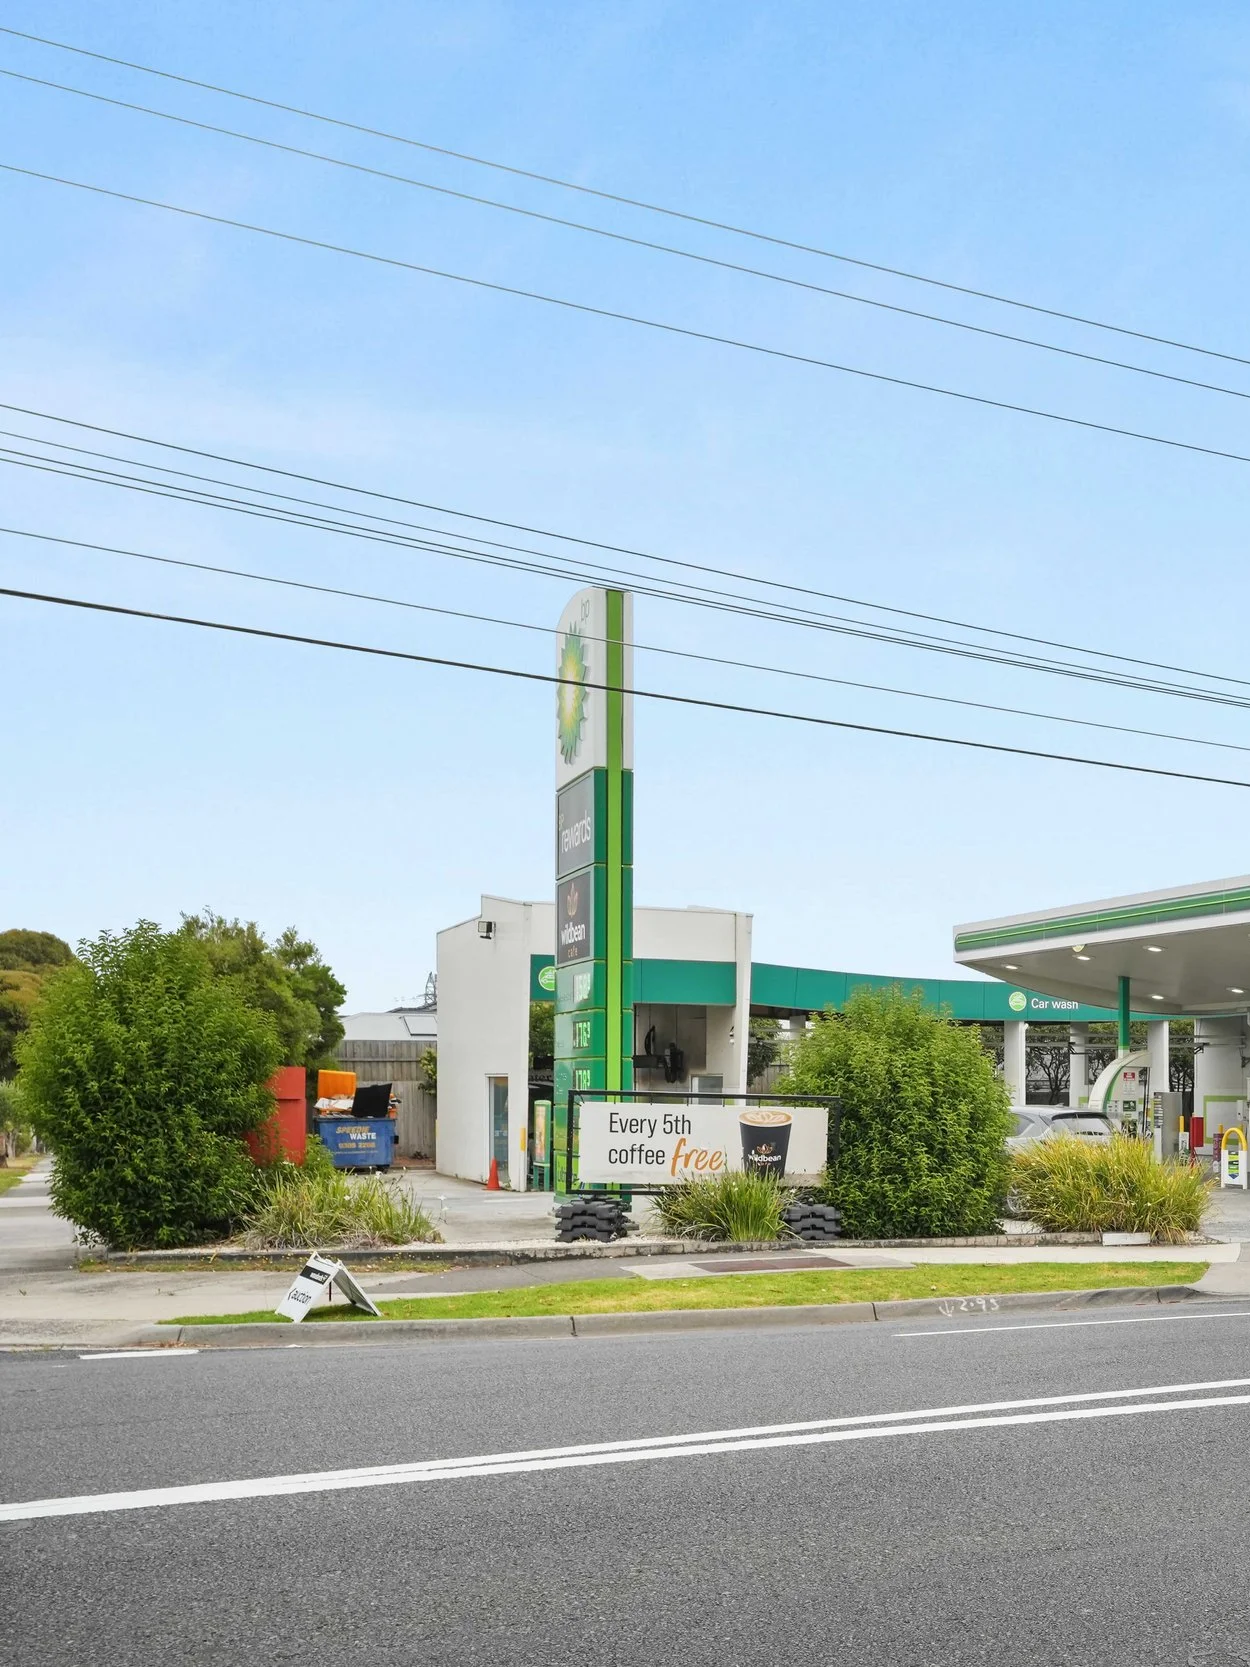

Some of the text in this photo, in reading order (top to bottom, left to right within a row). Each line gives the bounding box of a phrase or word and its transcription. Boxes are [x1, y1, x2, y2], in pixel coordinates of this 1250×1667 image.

[580, 598, 590, 624] bp
[561, 809, 591, 853] rewards
[561, 921, 586, 946] wildbean
[567, 945, 578, 959] cafe
[1031, 998, 1079, 1010] Car wash
[349, 1132, 377, 1141] WASTE
[609, 1112, 692, 1139] Every 5th
[608, 1137, 724, 1177] coffee free
[747, 1149, 782, 1163] wildbean
